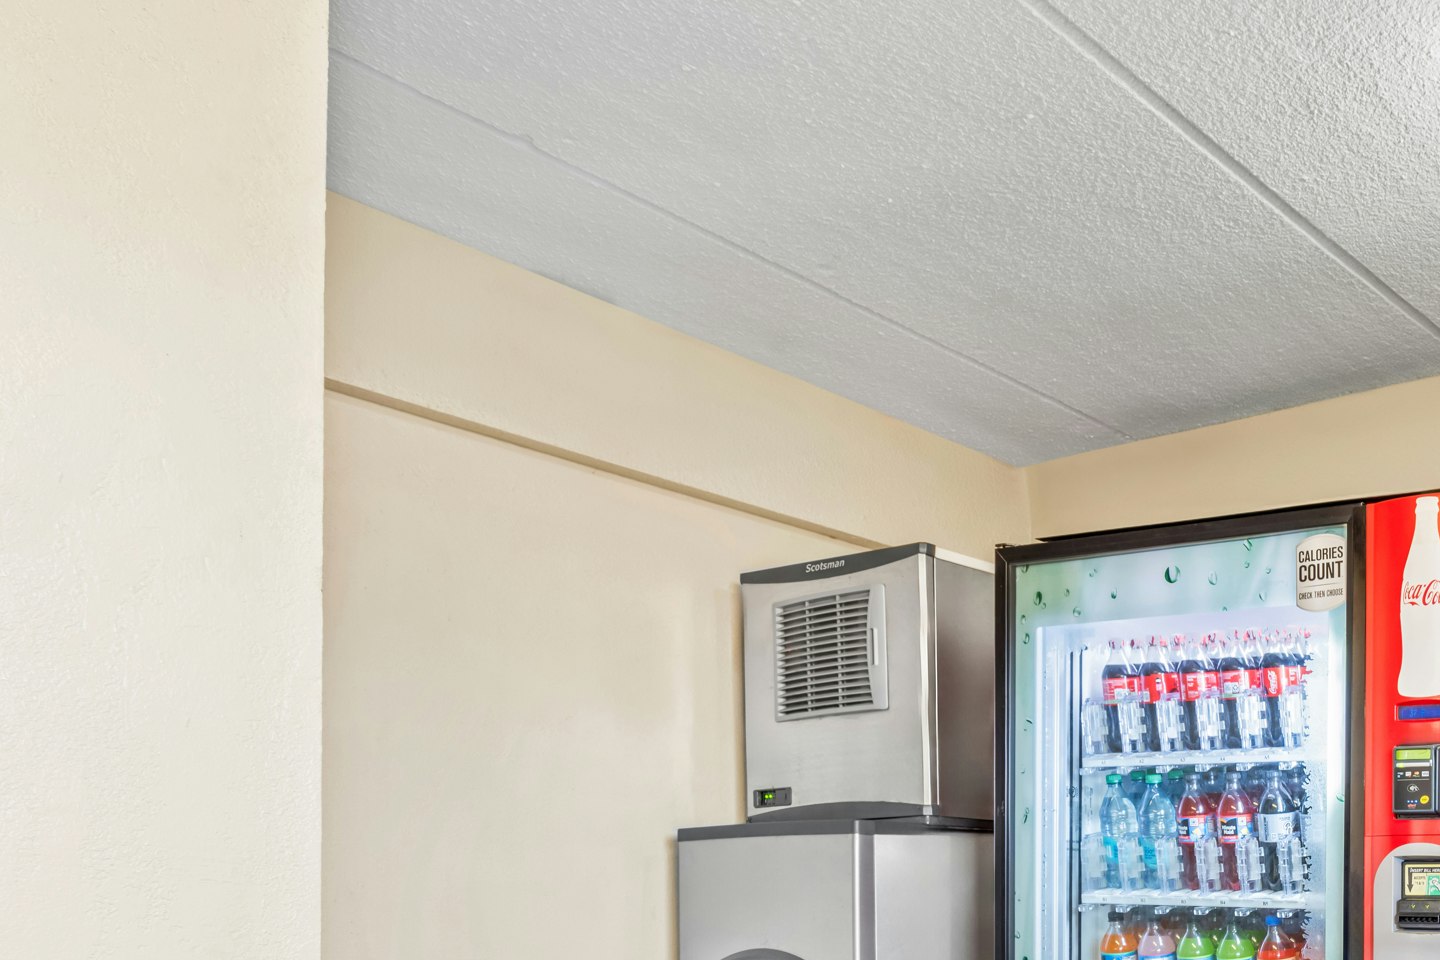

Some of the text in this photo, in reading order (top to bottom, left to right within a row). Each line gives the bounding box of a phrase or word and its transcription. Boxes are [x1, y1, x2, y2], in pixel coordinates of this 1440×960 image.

[1298, 545, 1344, 564] CALORIES
[805, 558, 846, 574] Scotsman
[1298, 560, 1344, 583] COUNT
[1298, 587, 1344, 601] CHECK THEN CHOOSE
